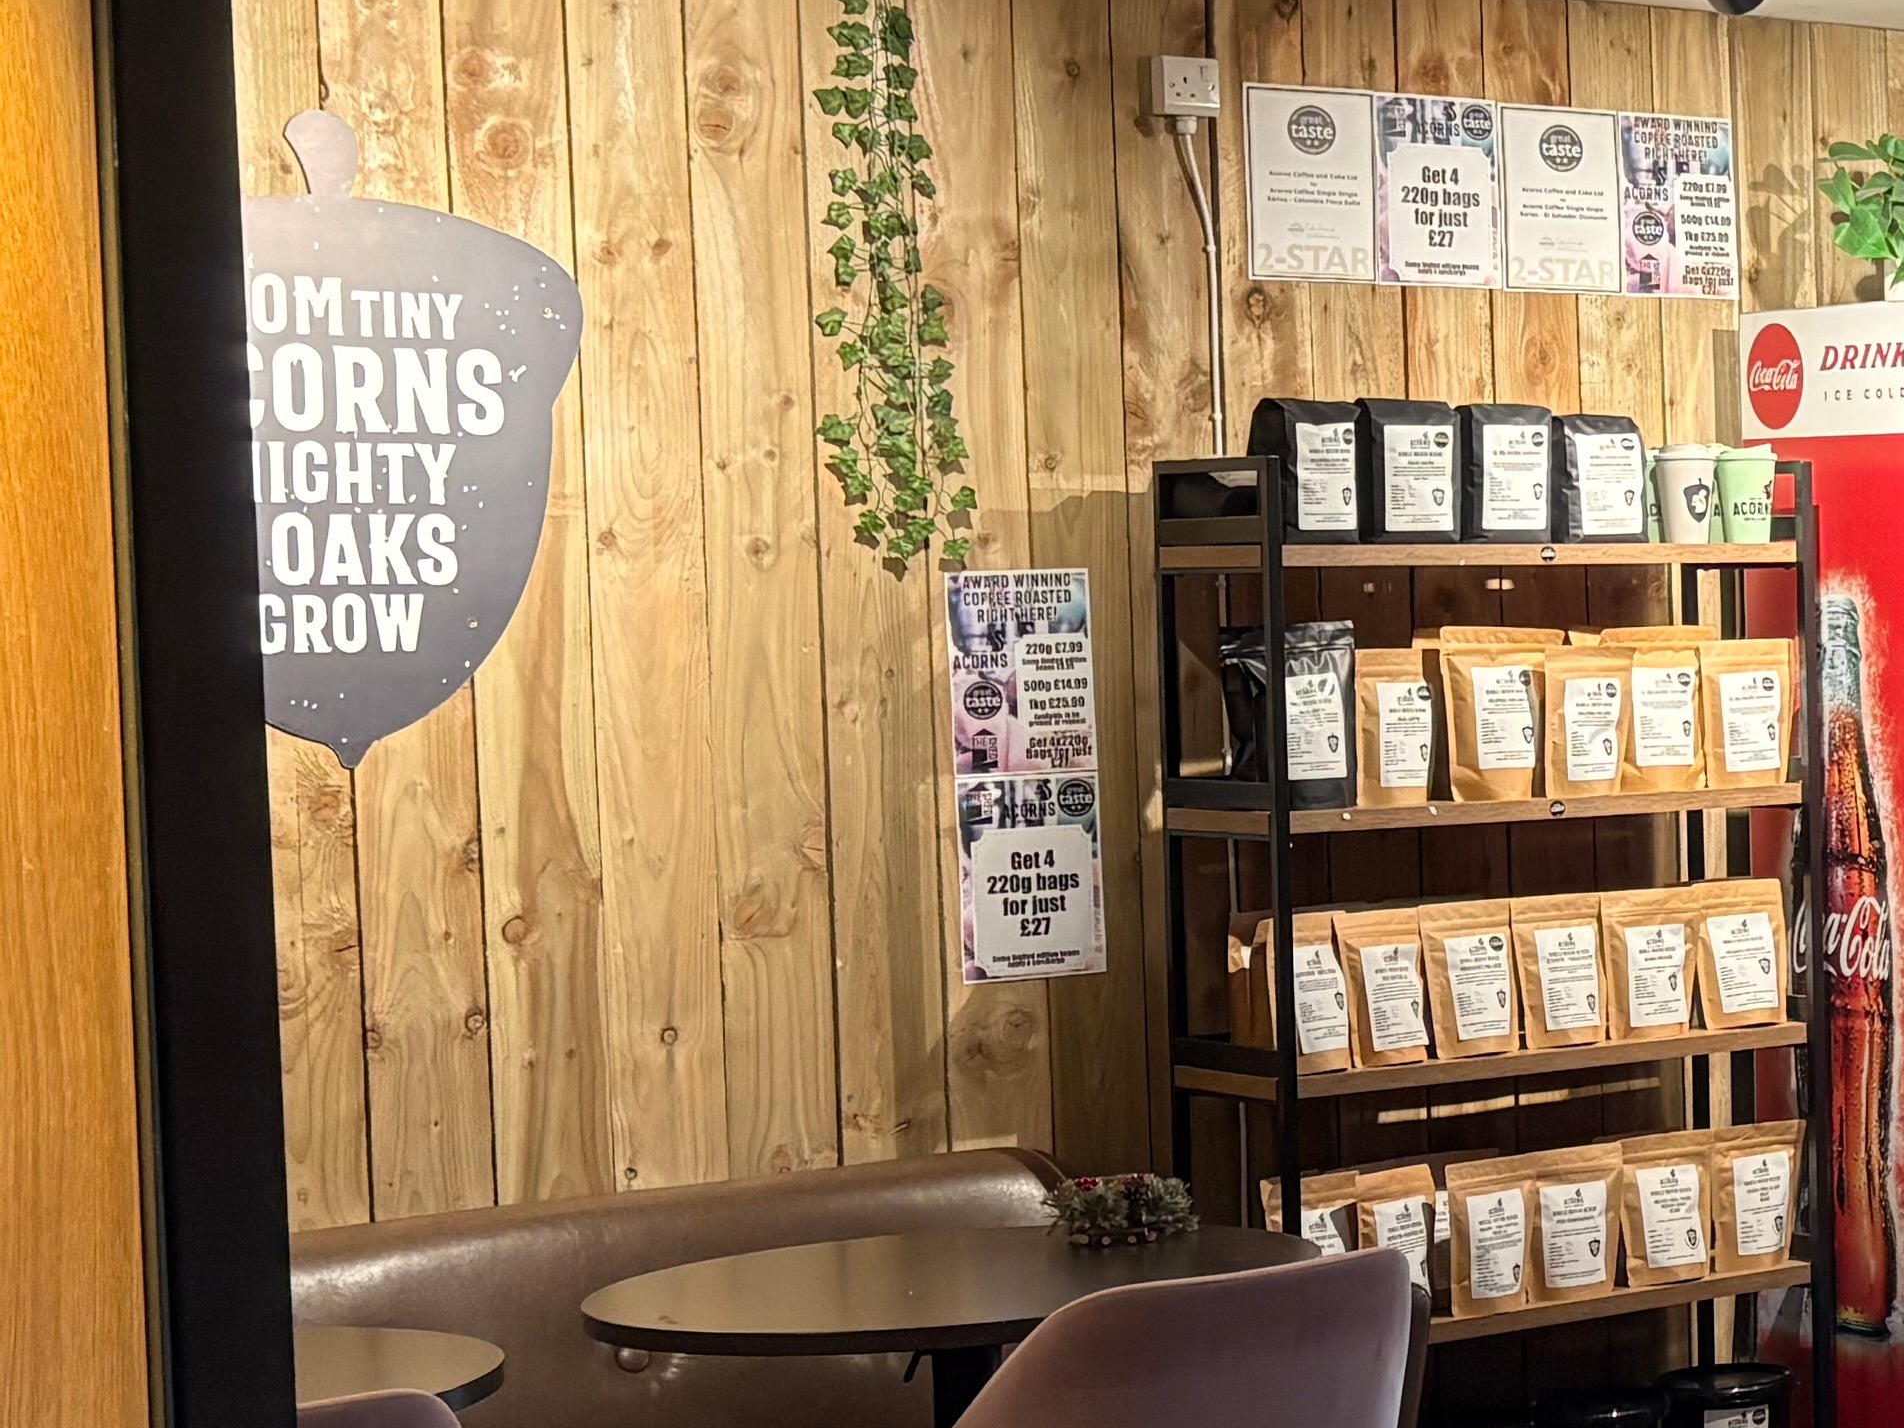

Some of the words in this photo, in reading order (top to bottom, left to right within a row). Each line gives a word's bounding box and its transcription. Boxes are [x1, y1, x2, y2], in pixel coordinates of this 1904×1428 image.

[1291, 125, 1333, 140] taste
[1634, 116, 1670, 131] AWARD
[1673, 118, 1718, 133] WINNING
[1634, 131, 1671, 146] COFFEE
[1674, 133, 1718, 149] ROASTED
[1542, 144, 1582, 158] taste
[1422, 166, 1446, 184] Get
[1450, 168, 1459, 184] 4
[1401, 186, 1438, 207] 220g
[1443, 190, 1480, 207] bags
[1624, 186, 1669, 201] ACORNS
[1415, 209, 1434, 225] for
[1438, 210, 1468, 228] just
[1429, 230, 1454, 247] £27
[1258, 243, 1368, 273] 2-STAR
[1512, 257, 1615, 285] 2-STAR
[350, 290, 463, 340] TINY
[1824, 389, 1852, 401] ICE
[271, 512, 459, 587] OAKS
[963, 575, 1009, 589] AWARD
[1014, 573, 1071, 587] WINNING
[964, 591, 1011, 606] COFFEE
[1016, 590, 1071, 604] ROASTED
[259, 593, 424, 654] GROW
[977, 608, 1014, 623] RIGHT
[1020, 606, 1058, 622] HERE!
[953, 654, 1008, 670] ACORNS
[1005, 802, 1056, 818] ACORNS
[1011, 851, 1040, 870] Get
[1044, 849, 1055, 866] 4
[987, 875, 1032, 895] 220g
[1036, 873, 1080, 891] bags
[1003, 897, 1028, 916] for
[1032, 895, 1066, 915] just
[1020, 917, 1051, 937] £27
